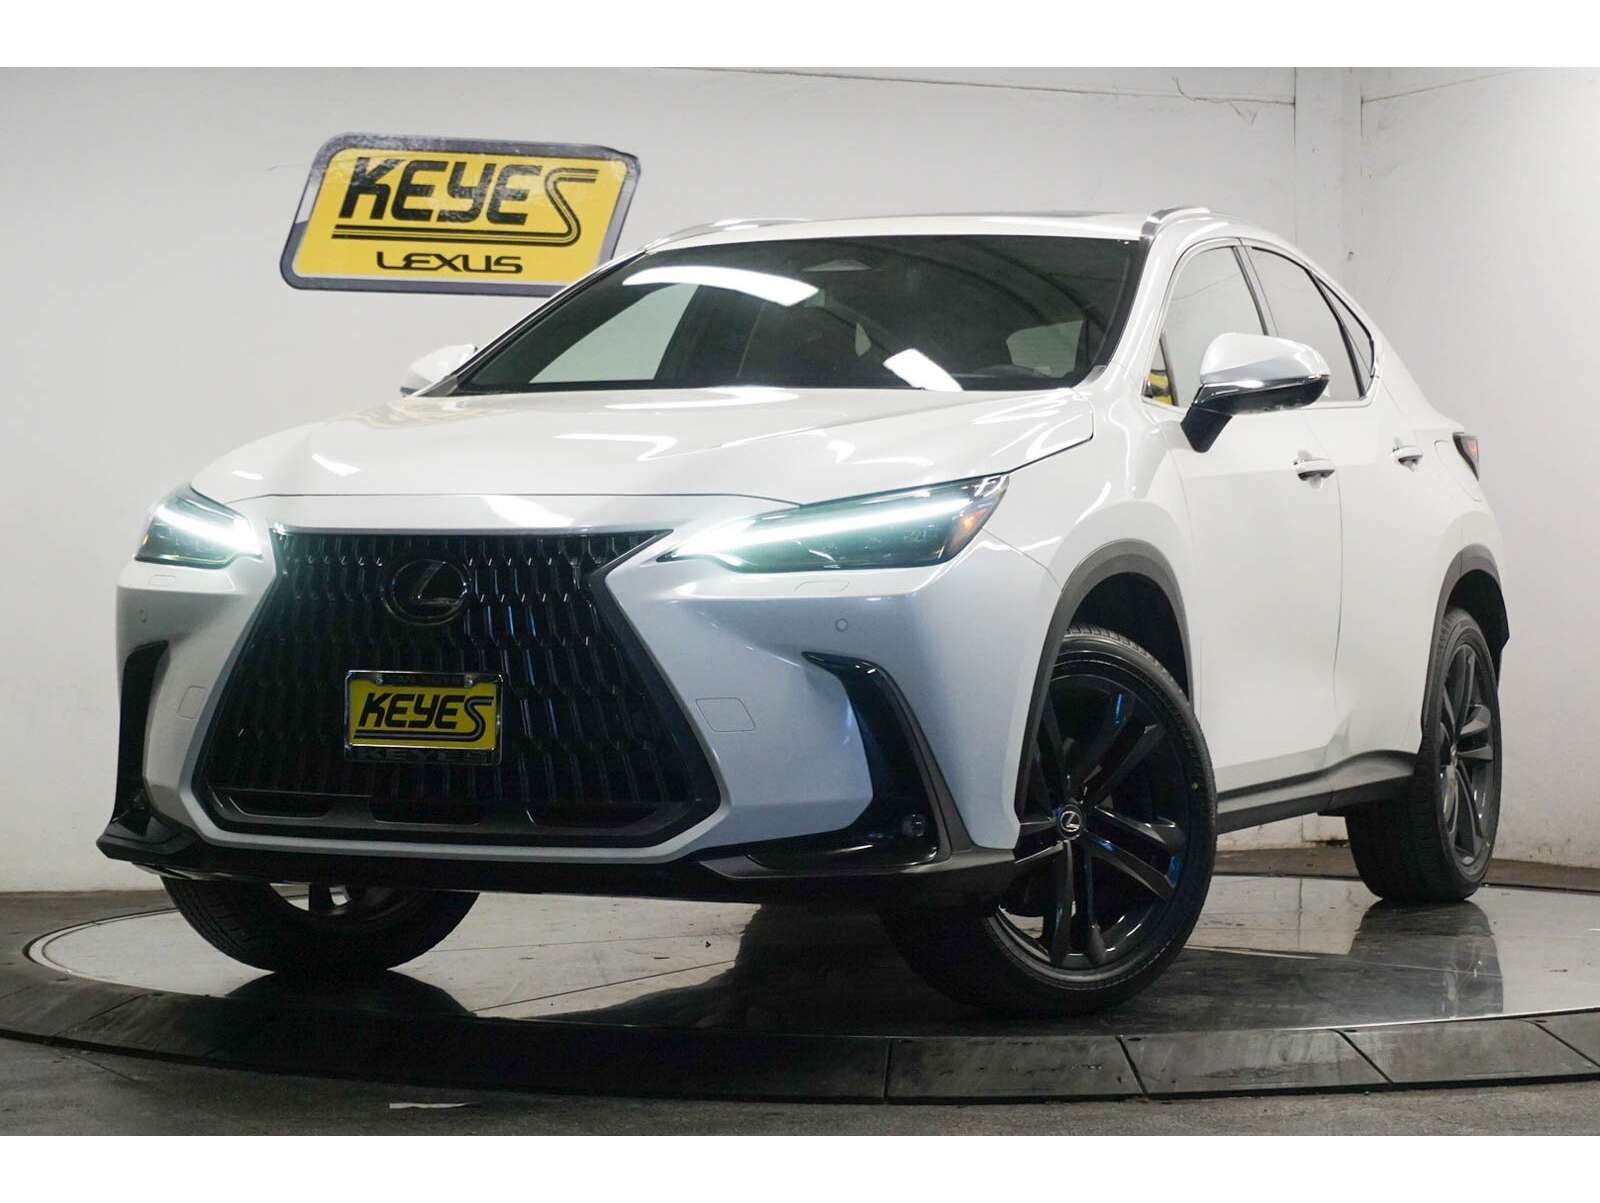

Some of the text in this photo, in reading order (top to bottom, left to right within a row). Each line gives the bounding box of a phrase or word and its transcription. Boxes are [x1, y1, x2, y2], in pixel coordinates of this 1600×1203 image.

[331, 156, 599, 247] KEYES
[376, 251, 524, 274] LEXUS
[353, 692, 495, 742] KEYES
